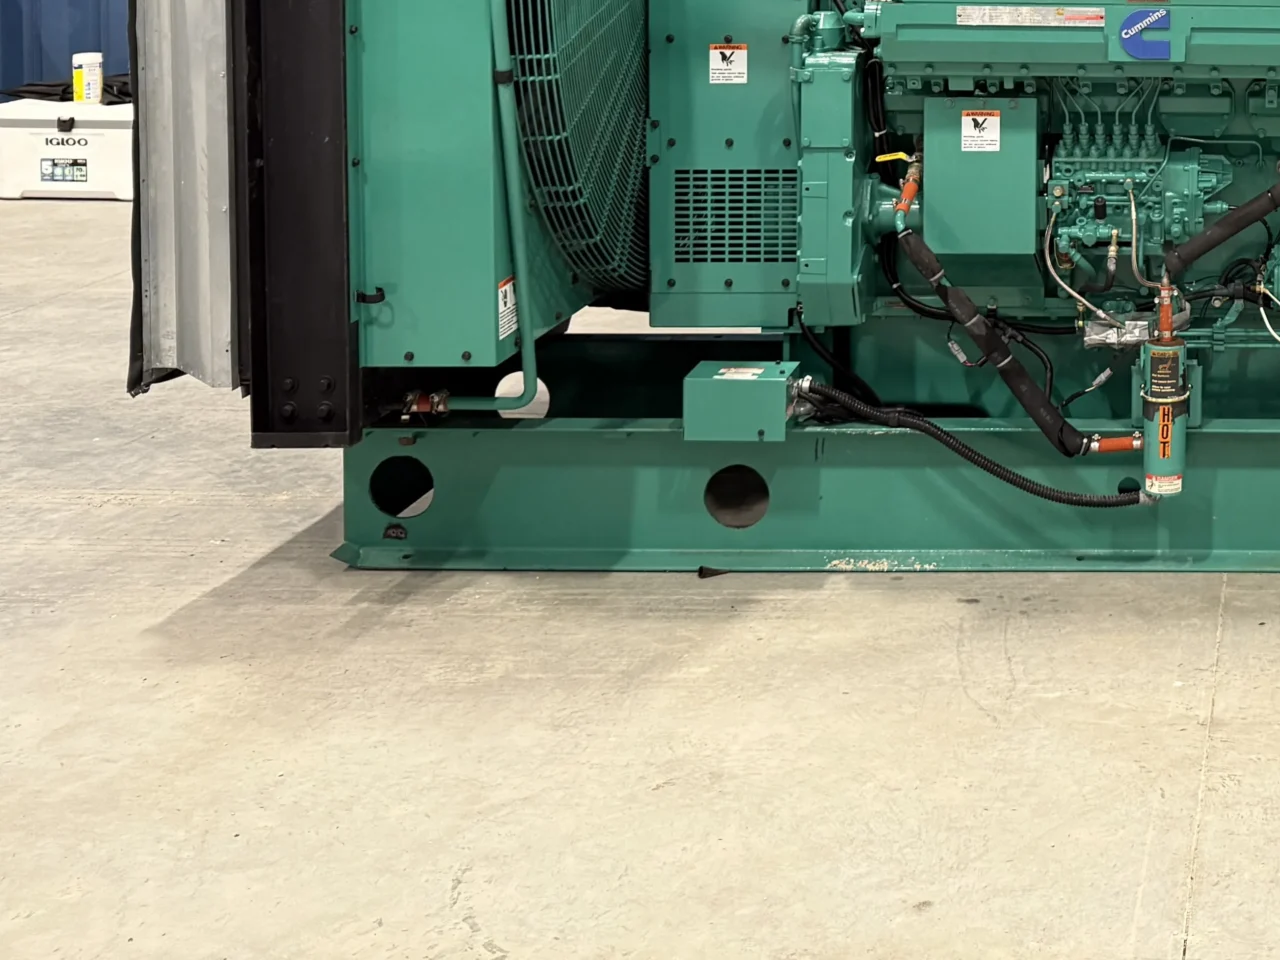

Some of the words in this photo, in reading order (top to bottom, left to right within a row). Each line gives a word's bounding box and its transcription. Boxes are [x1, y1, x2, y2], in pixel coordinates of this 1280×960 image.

[1121, 8, 1167, 39] Cummins
[45, 137, 88, 146] IGLOO
[1160, 407, 1170, 458] HOT
